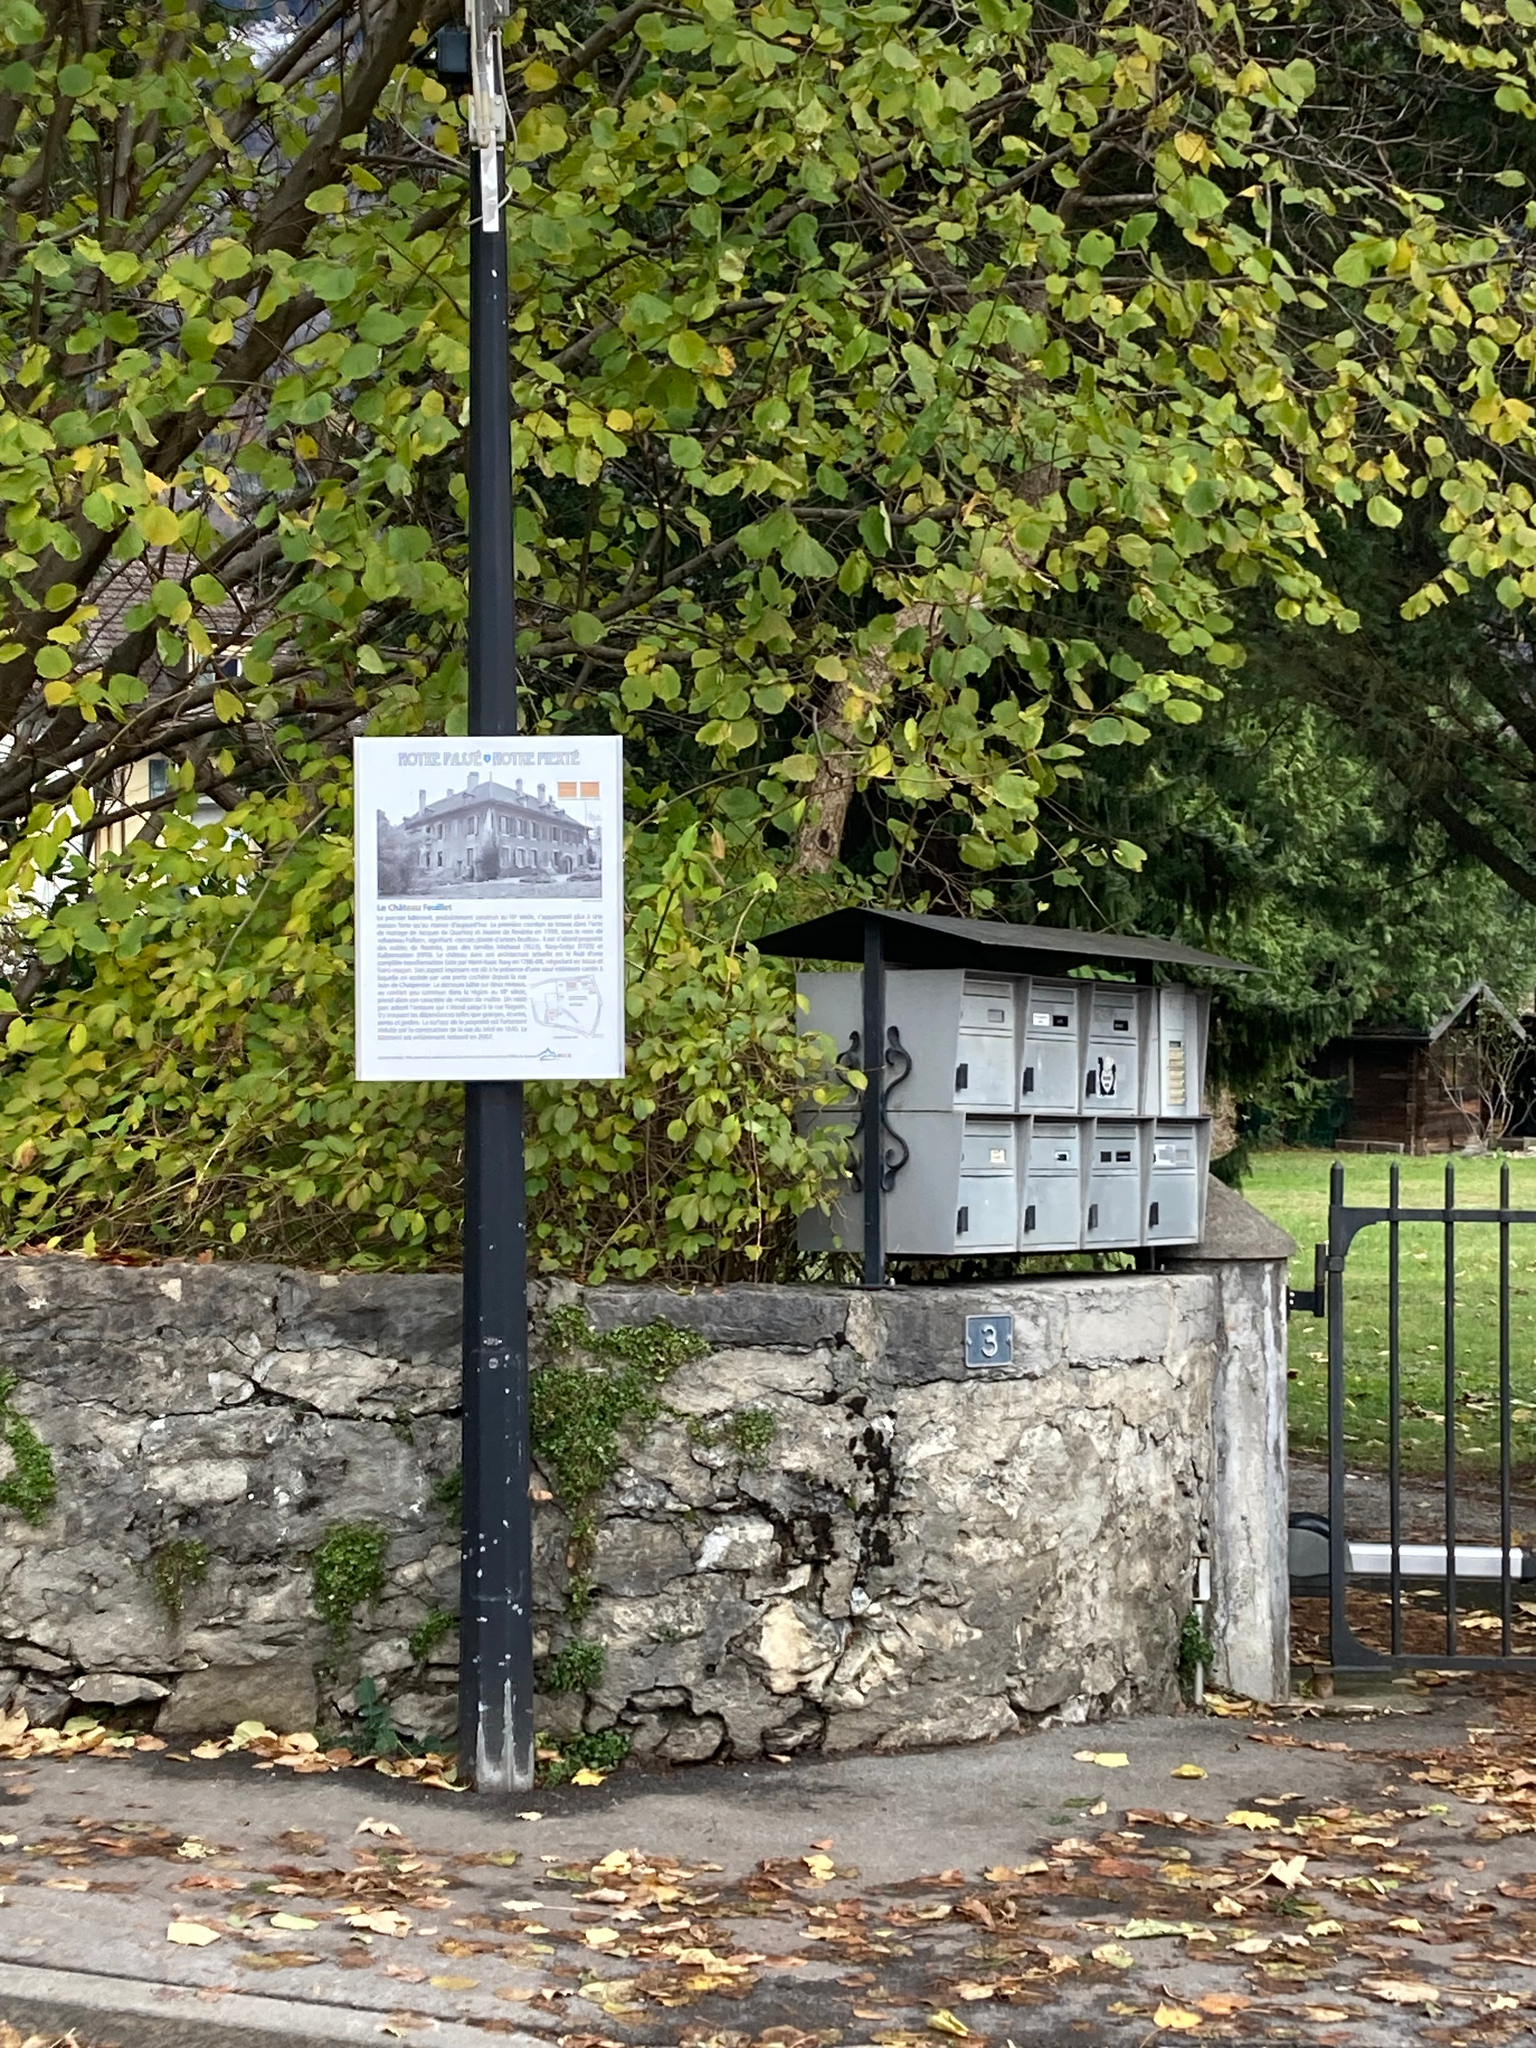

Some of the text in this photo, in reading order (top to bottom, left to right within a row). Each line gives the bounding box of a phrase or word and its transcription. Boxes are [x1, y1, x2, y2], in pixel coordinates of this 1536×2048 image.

[398, 751, 441, 766] NOTRE
[443, 750, 482, 766] PASSÉ
[492, 751, 535, 766] NOTRE
[376, 903, 387, 912] Le
[388, 903, 422, 912] Château
[980, 1323, 998, 1359] 3
